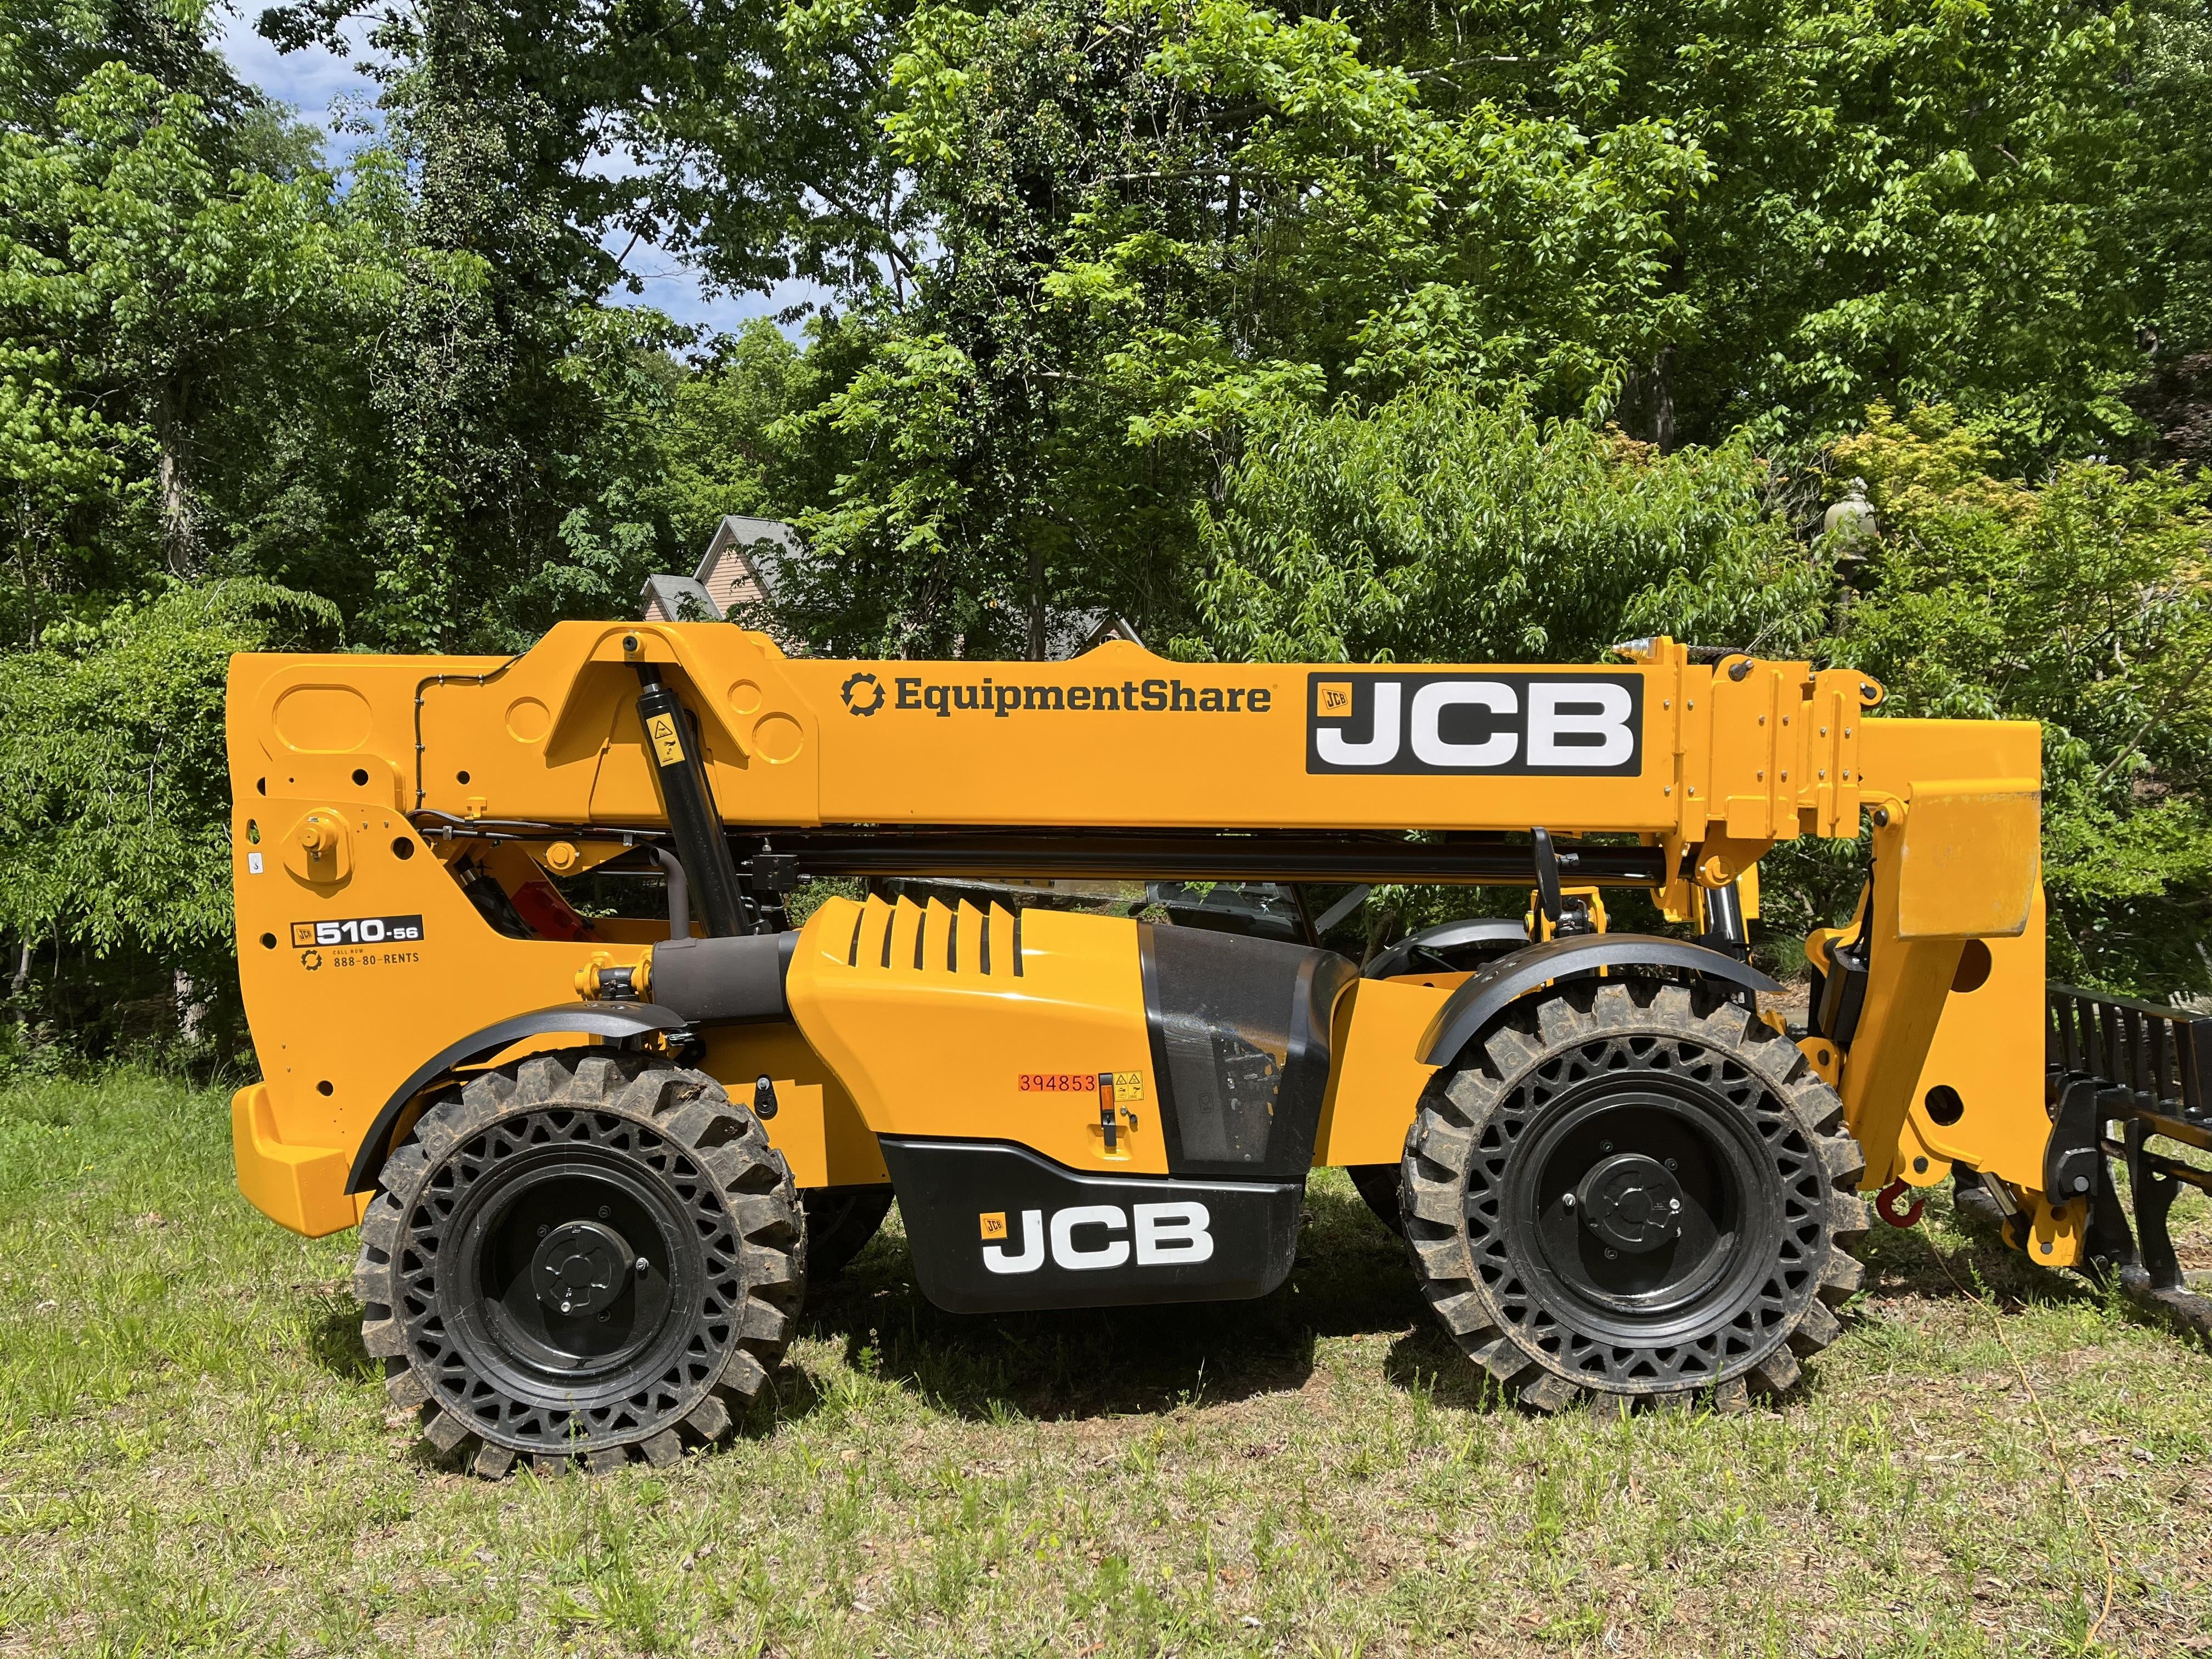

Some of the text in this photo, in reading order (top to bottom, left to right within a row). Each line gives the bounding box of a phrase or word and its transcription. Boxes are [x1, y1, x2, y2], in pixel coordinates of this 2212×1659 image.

[895, 678, 1271, 718] EquipmentShare
[1327, 691, 1346, 708] JCB
[1316, 681, 1634, 767] JCB
[299, 930, 312, 940] JCB
[316, 919, 419, 945] 510-56
[334, 952, 420, 968] 888-80-RENTS
[1020, 1074, 1096, 1092] 394853
[987, 1220, 1002, 1232] JCB
[982, 1201, 1215, 1274] JCB
